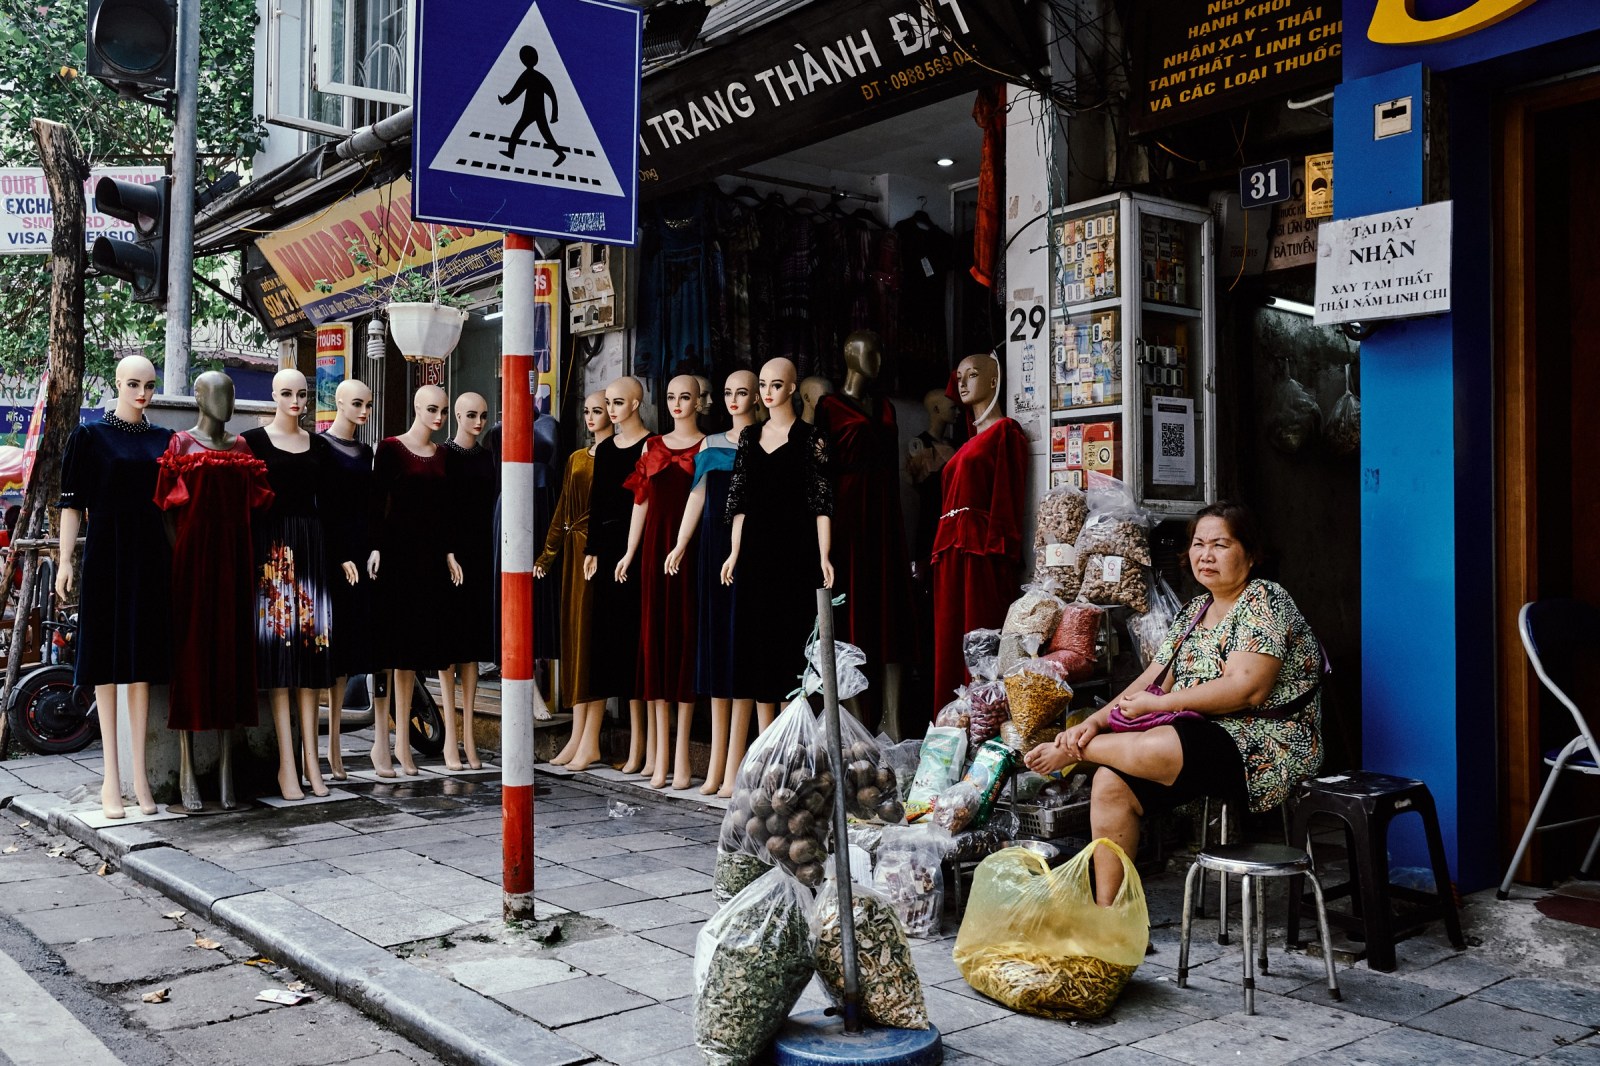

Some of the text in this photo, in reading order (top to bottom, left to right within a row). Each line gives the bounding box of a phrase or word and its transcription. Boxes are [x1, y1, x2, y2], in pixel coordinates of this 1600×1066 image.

[1164, 42, 1215, 69] NHẬN
[1218, 28, 1256, 51] XAY
[1277, 6, 1322, 31] THÁI
[1189, 13, 1238, 39] HẠNH
[1149, 70, 1186, 91] TAM
[1188, 52, 1234, 79] THẤT
[1255, 34, 1301, 58] LINH
[1308, 20, 1343, 42] CHI
[646, 81, 756, 150] TRANG
[754, 29, 882, 107] THÀNH
[861, 80, 882, 101] ĐT
[890, 65, 926, 90] 0988
[1150, 42, 1342, 112] VÀ CÁC LOẠI THUỐC
[1250, 168, 1278, 199] 31
[8, 232, 47, 245] VISA
[1352, 216, 1414, 239] TẠI ĐÂY
[274, 219, 371, 293] WANDER
[1348, 238, 1416, 265] NHẬN
[1331, 269, 1433, 295] XAY TAM THẤT
[263, 292, 287, 318] SIM
[1319, 288, 1447, 312] THÁI NẤM LINH CHI
[1010, 305, 1046, 342] 29
[319, 333, 342, 347] TOURS
